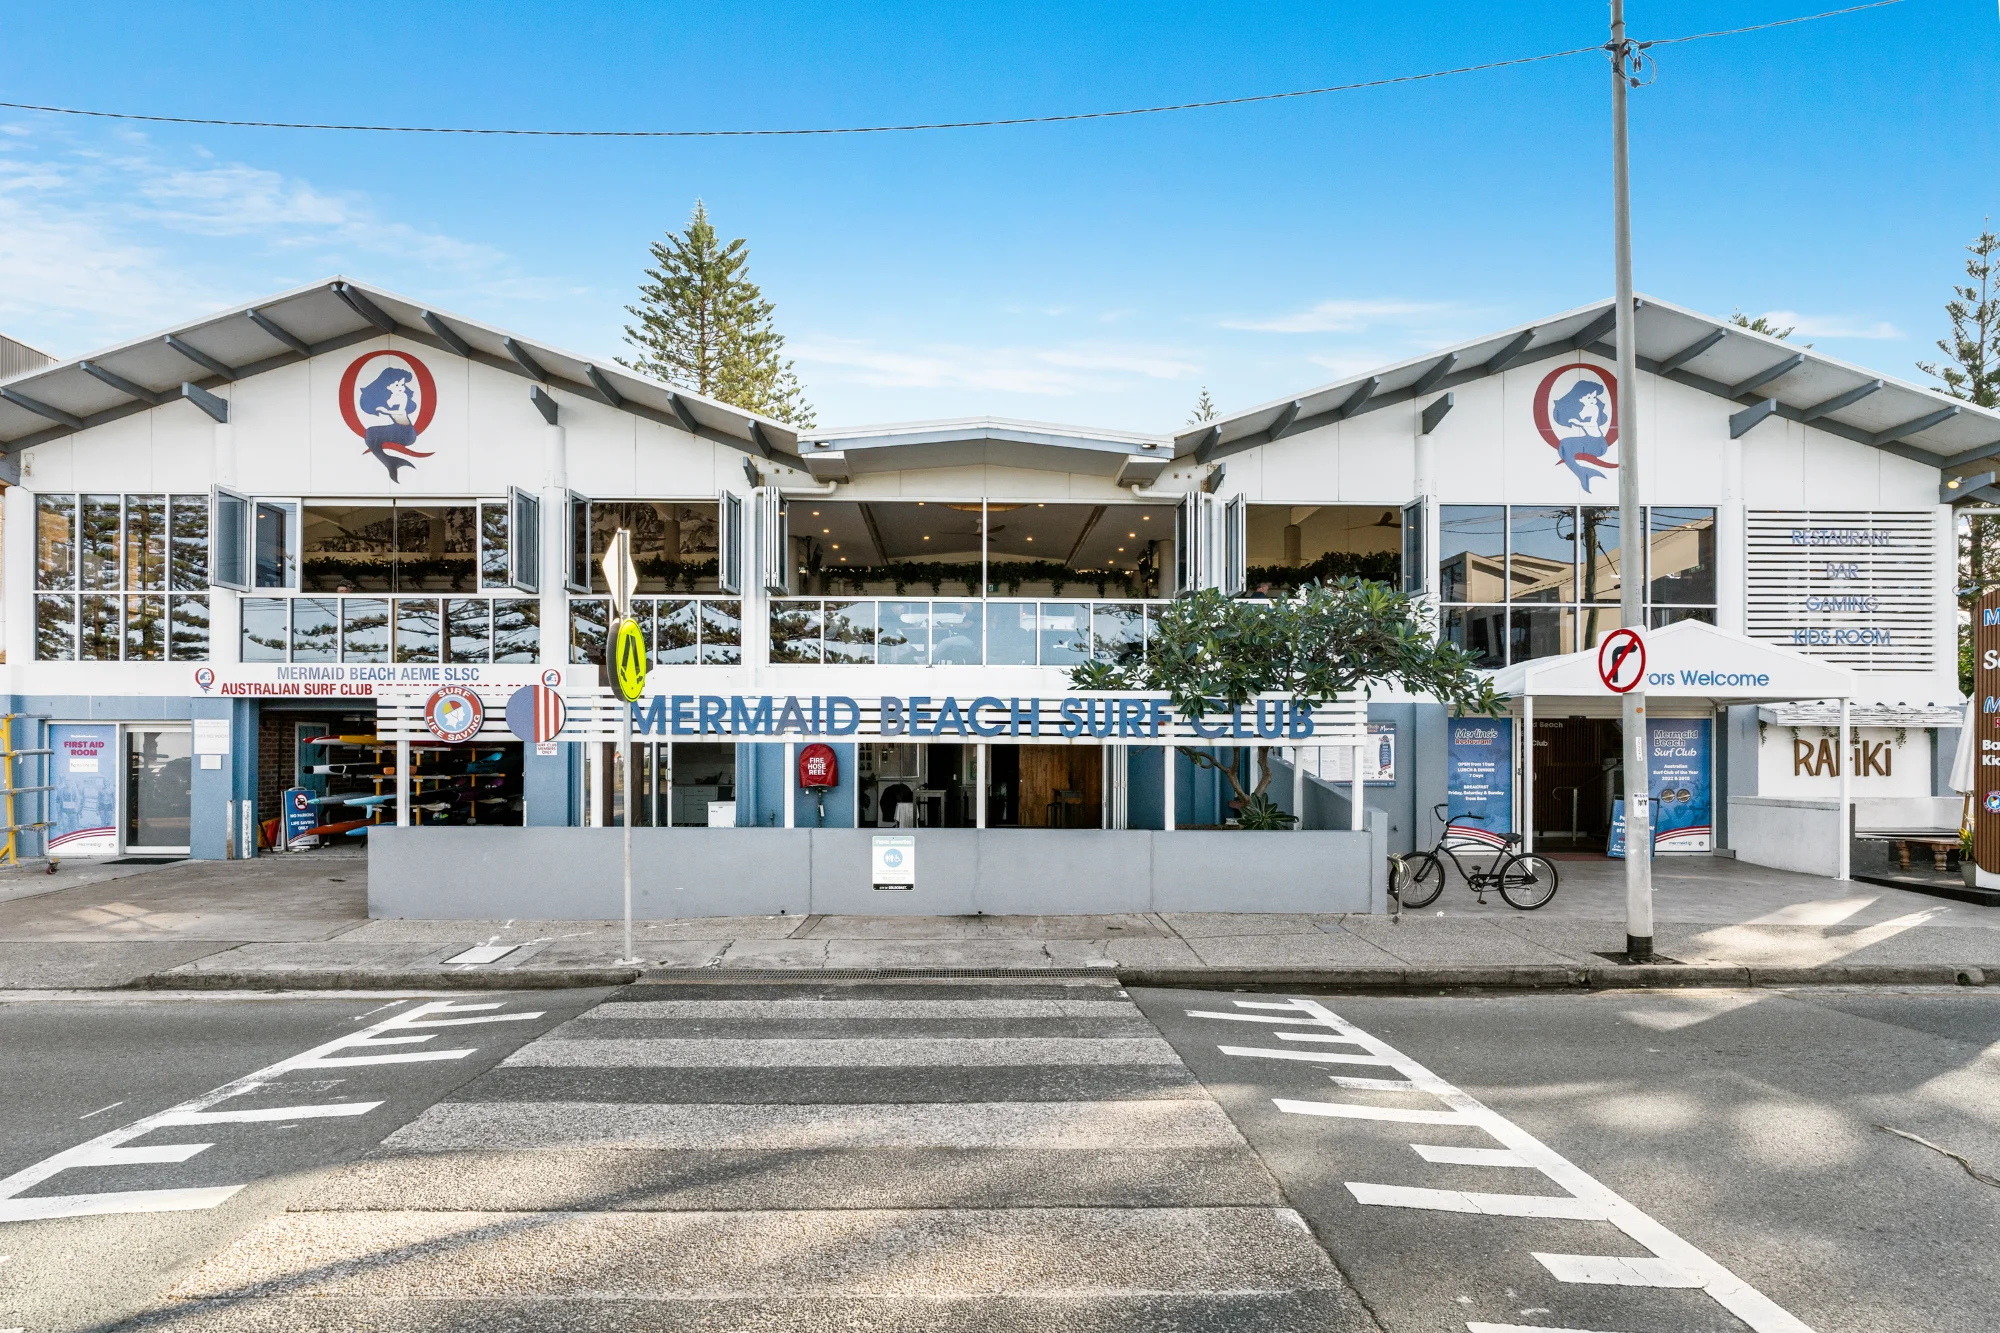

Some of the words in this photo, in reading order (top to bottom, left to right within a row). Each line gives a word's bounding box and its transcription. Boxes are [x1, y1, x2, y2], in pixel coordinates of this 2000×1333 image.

[1792, 530, 1891, 545] RESTAURANT
[1826, 562, 1859, 578] BAR
[1806, 596, 1879, 611] GAMING
[1794, 629, 1829, 645] KIDS
[1835, 628, 1891, 645] ROOM
[277, 667, 345, 680] MERMAID
[350, 667, 396, 680] BEACH
[401, 668, 440, 680] AEME
[444, 668, 479, 681] SLSC
[1680, 670, 1770, 687] Welcome
[221, 683, 300, 695] AUSTRALIAN
[304, 683, 337, 696] SURF
[340, 683, 373, 696] CLUB
[437, 687, 471, 698] SURF
[629, 695, 861, 736] MERMAID
[880, 696, 1040, 737] BEACH
[1059, 697, 1172, 739] SURF
[1191, 698, 1314, 739] CLUB
[426, 715, 445, 738] LIFE
[447, 714, 480, 741] SAVING
[1653, 729, 1699, 738] Mermaid
[1653, 738, 1686, 747] Beach
[1653, 747, 1675, 757] Surf
[1675, 747, 1697, 757] Club
